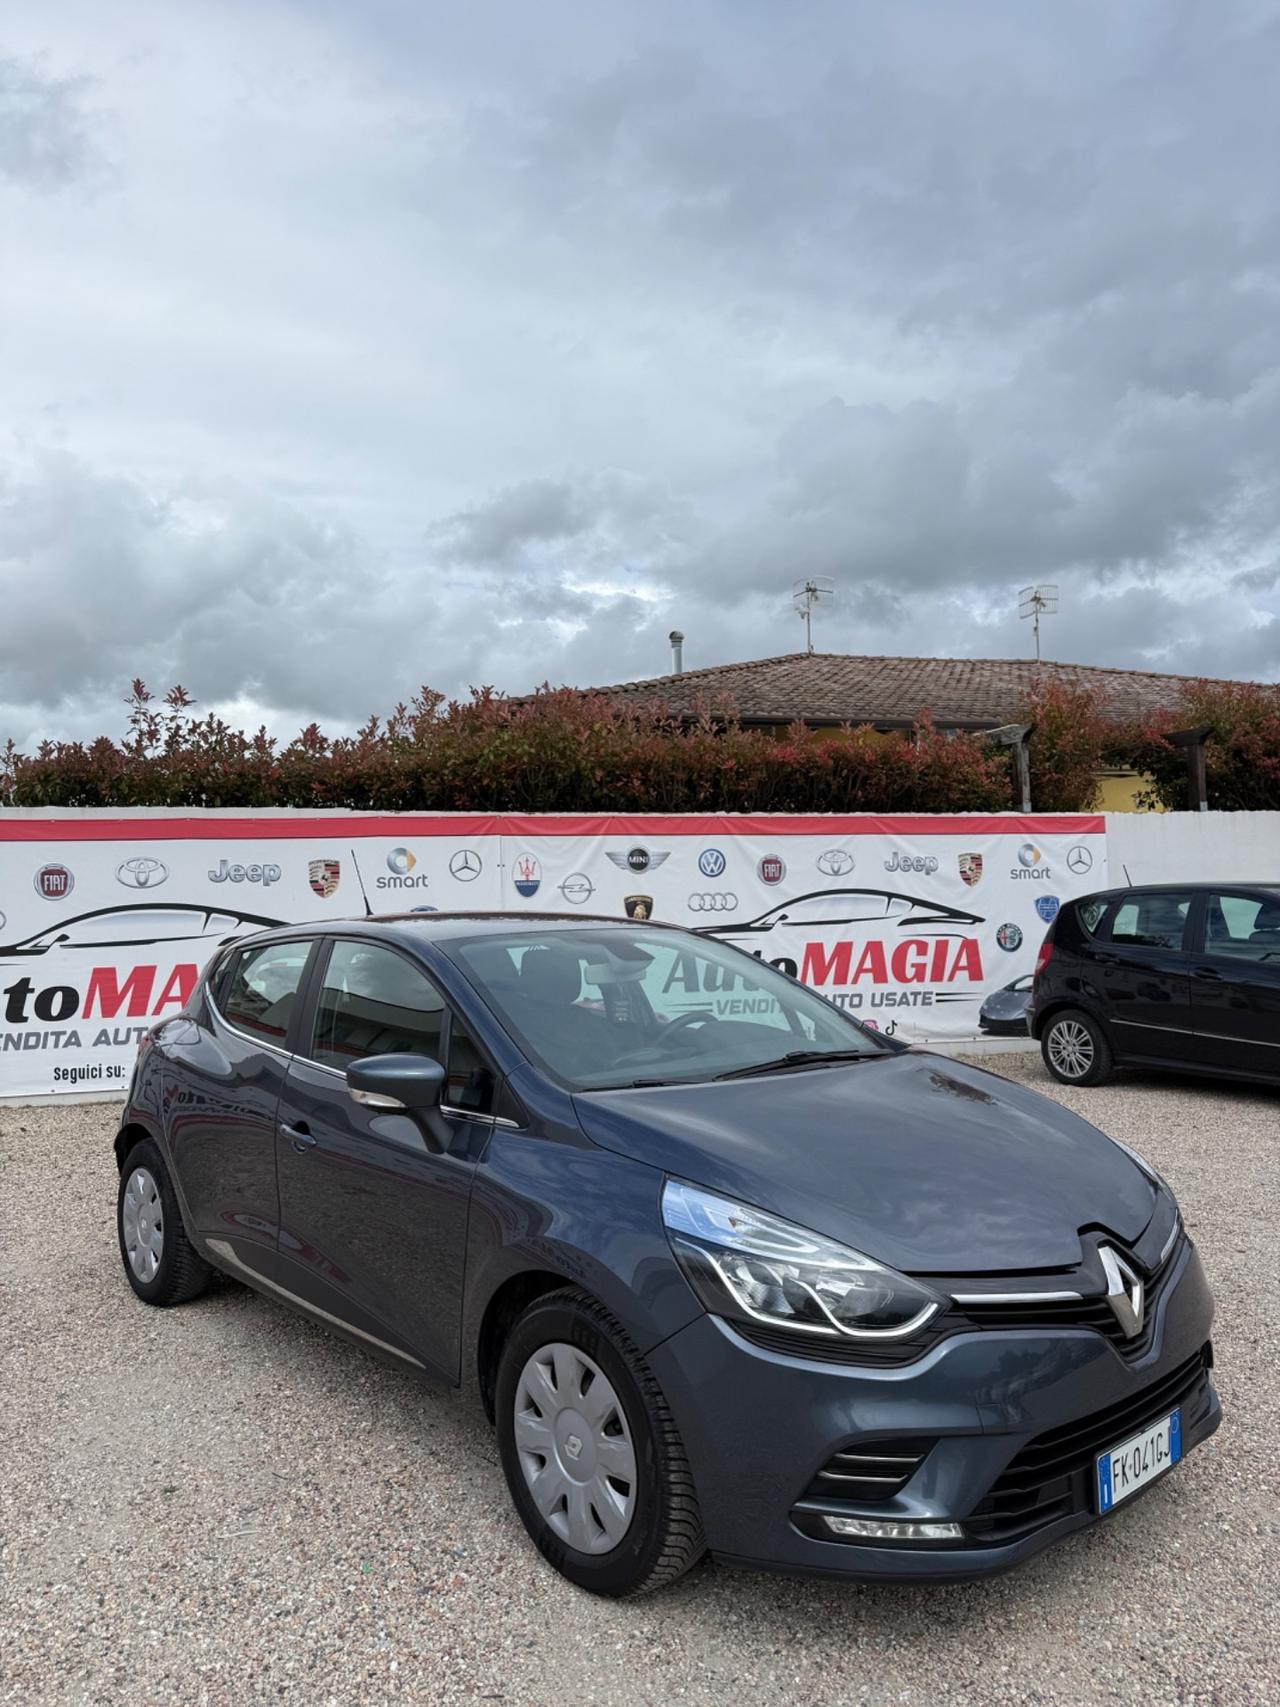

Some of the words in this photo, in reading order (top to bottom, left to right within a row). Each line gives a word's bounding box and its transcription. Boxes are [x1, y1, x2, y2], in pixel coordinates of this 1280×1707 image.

[628, 856, 649, 865] MINI
[884, 852, 939, 875] Jeep
[208, 860, 282, 886] Jeep
[764, 864, 781, 878] FIAT
[1010, 866, 1051, 880] smart
[44, 874, 66, 892] FIAT
[376, 874, 429, 889] smart
[717, 998, 783, 1015] VENDI
[870, 991, 934, 1007] USATE
[54, 1063, 102, 1084] Seguici
[106, 1065, 126, 1079] su:
